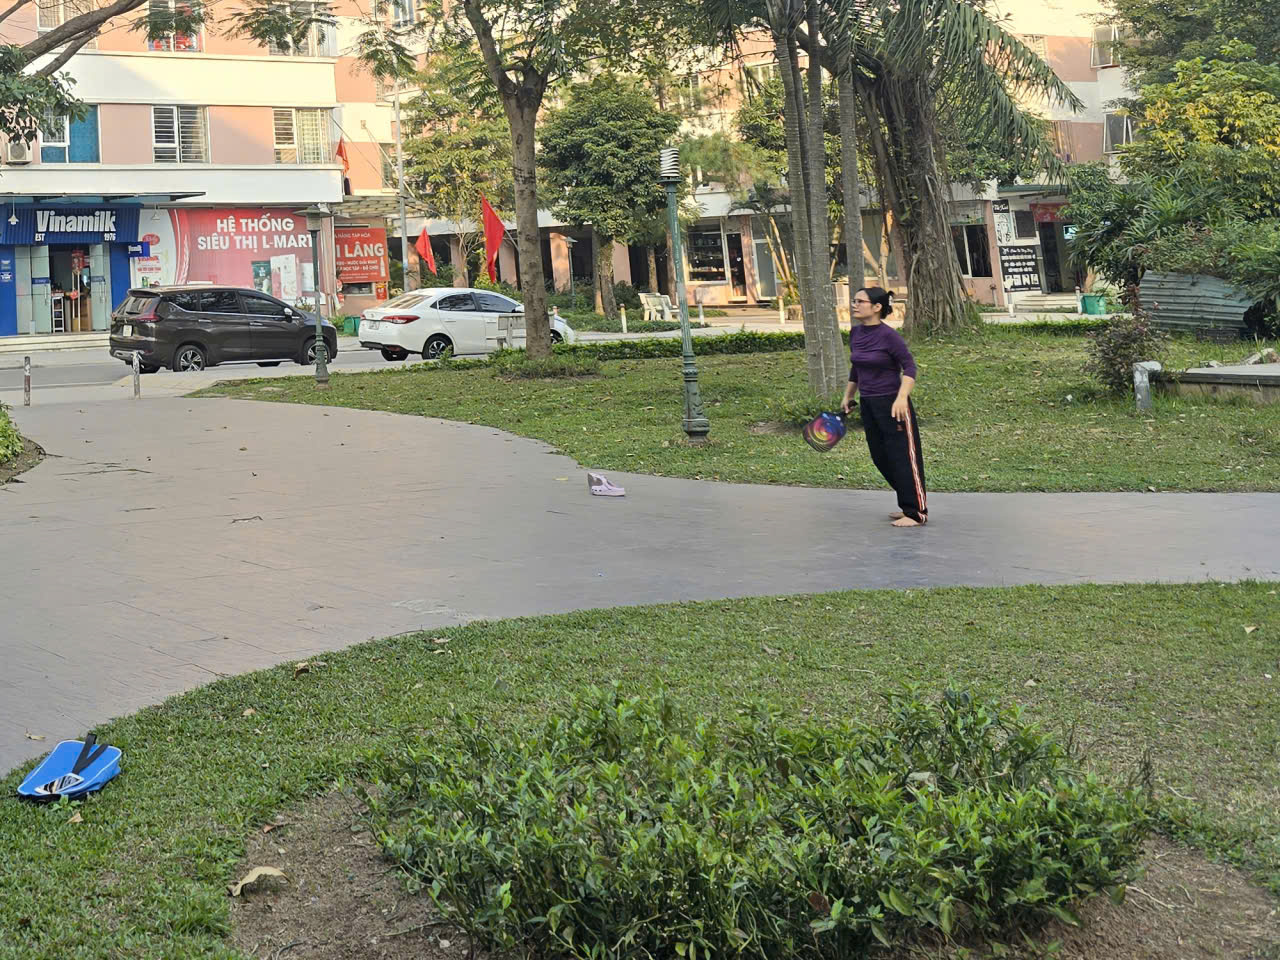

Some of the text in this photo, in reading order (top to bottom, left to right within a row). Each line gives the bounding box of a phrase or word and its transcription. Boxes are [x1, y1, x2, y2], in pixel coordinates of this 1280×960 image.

[36, 210, 117, 232] Vinamilk
[216, 212, 295, 236] HỆ THỐNG
[35, 233, 116, 241] EST 1976
[197, 232, 230, 250] SIÊU
[234, 235, 258, 253] THỊ
[344, 240, 385, 258] LÂNG
